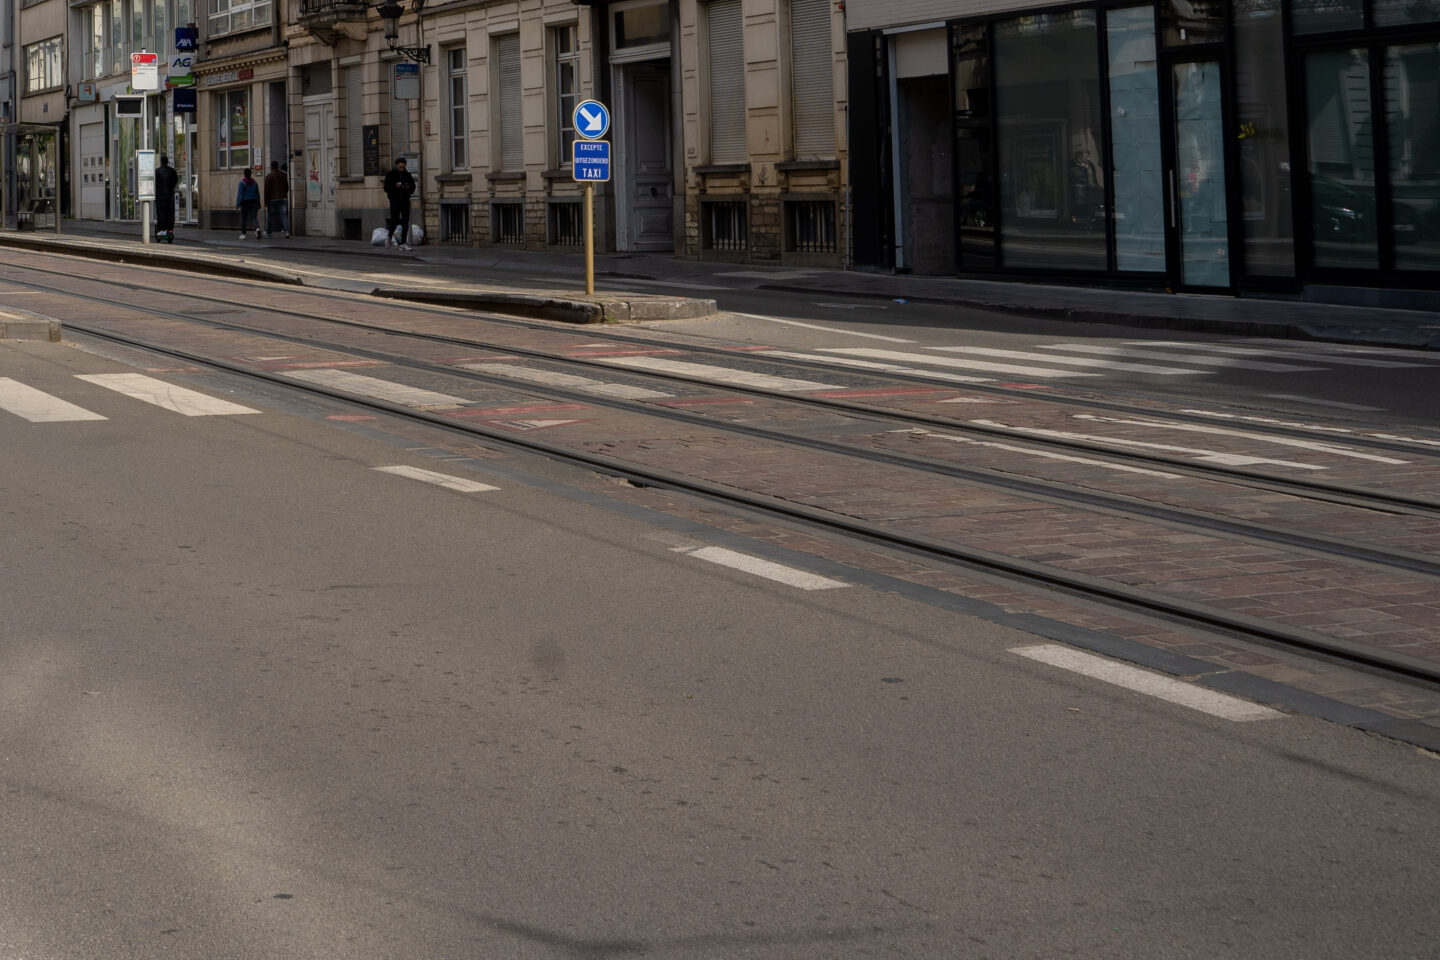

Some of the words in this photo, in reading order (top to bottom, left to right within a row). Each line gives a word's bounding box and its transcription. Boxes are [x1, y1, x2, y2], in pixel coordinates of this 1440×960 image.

[176, 38, 192, 47] AXA
[172, 57, 192, 68] AG
[582, 168, 601, 178] TAXI
